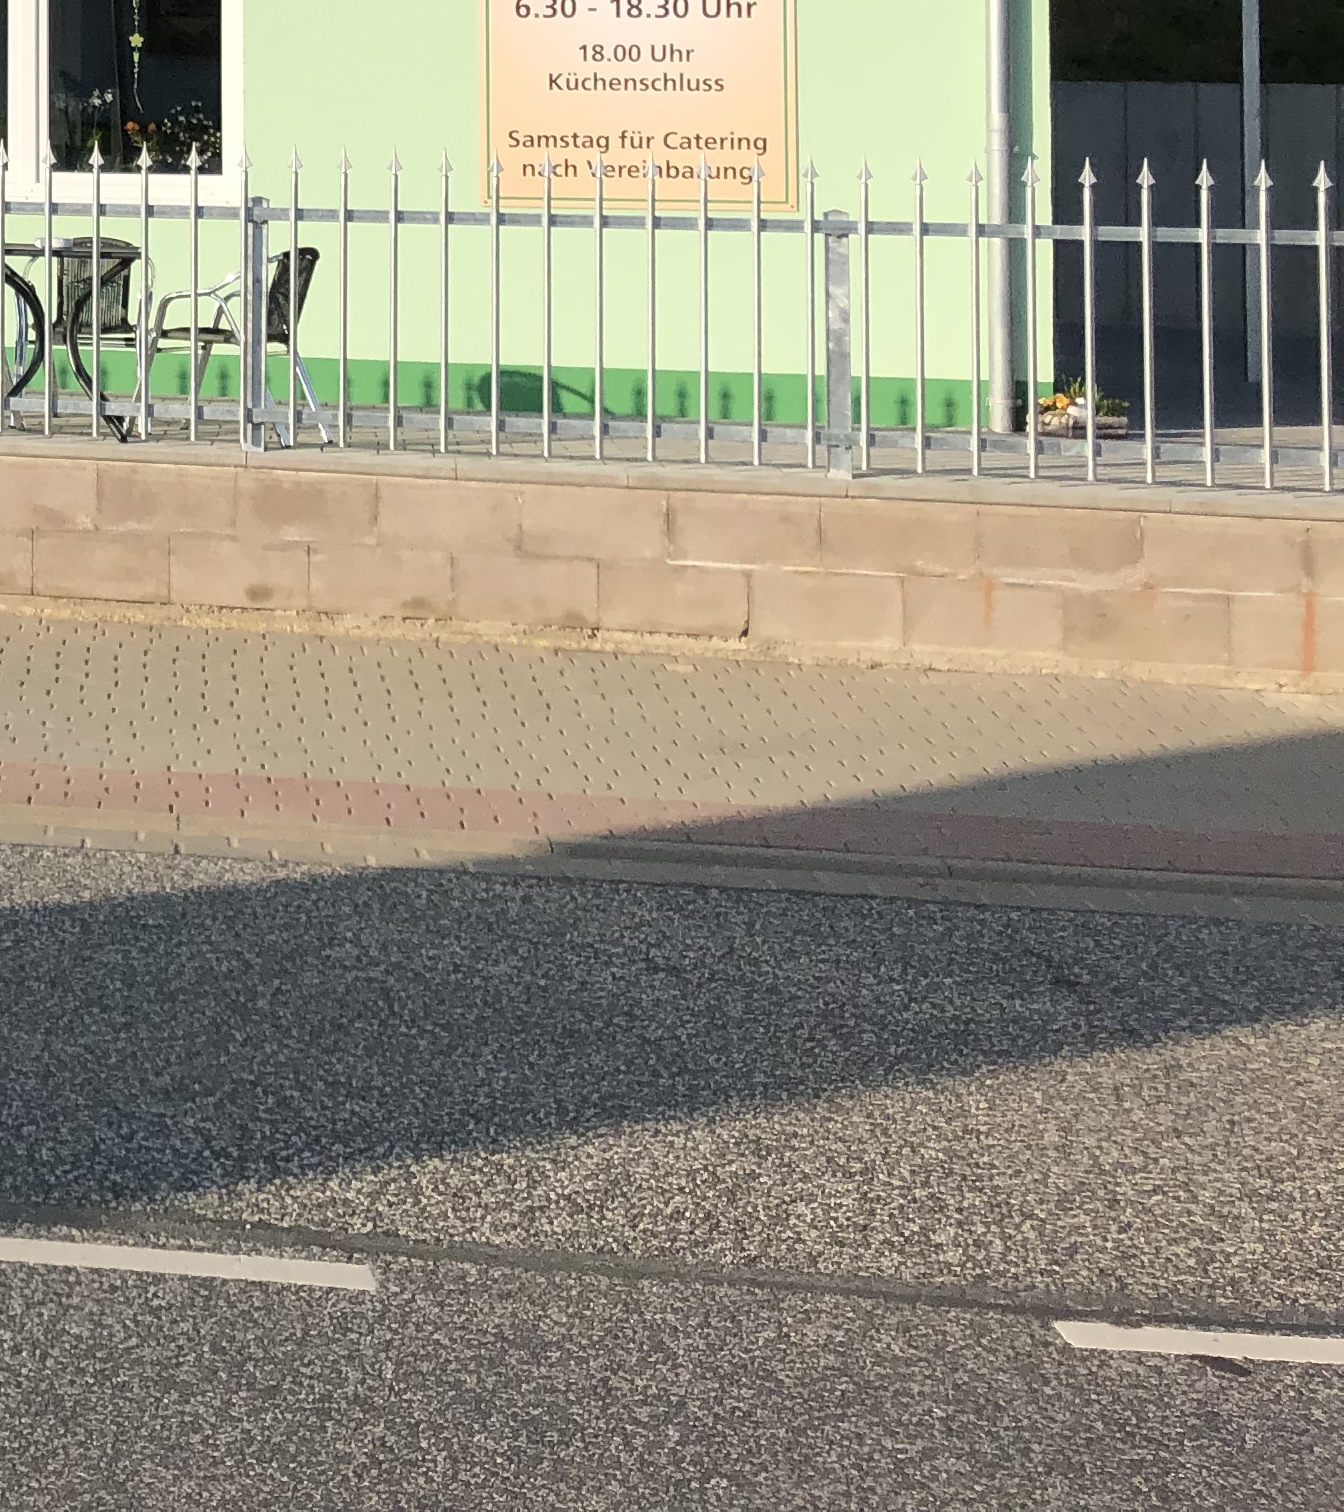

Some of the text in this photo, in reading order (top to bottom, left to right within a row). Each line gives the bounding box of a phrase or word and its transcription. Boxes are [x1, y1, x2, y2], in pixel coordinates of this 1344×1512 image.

[578, 43, 695, 63] 18.00 Uhr
[548, 71, 725, 92] Küchenschluss
[508, 129, 768, 156] Samstag für Catering
[586, 159, 753, 186] ereinbaung
